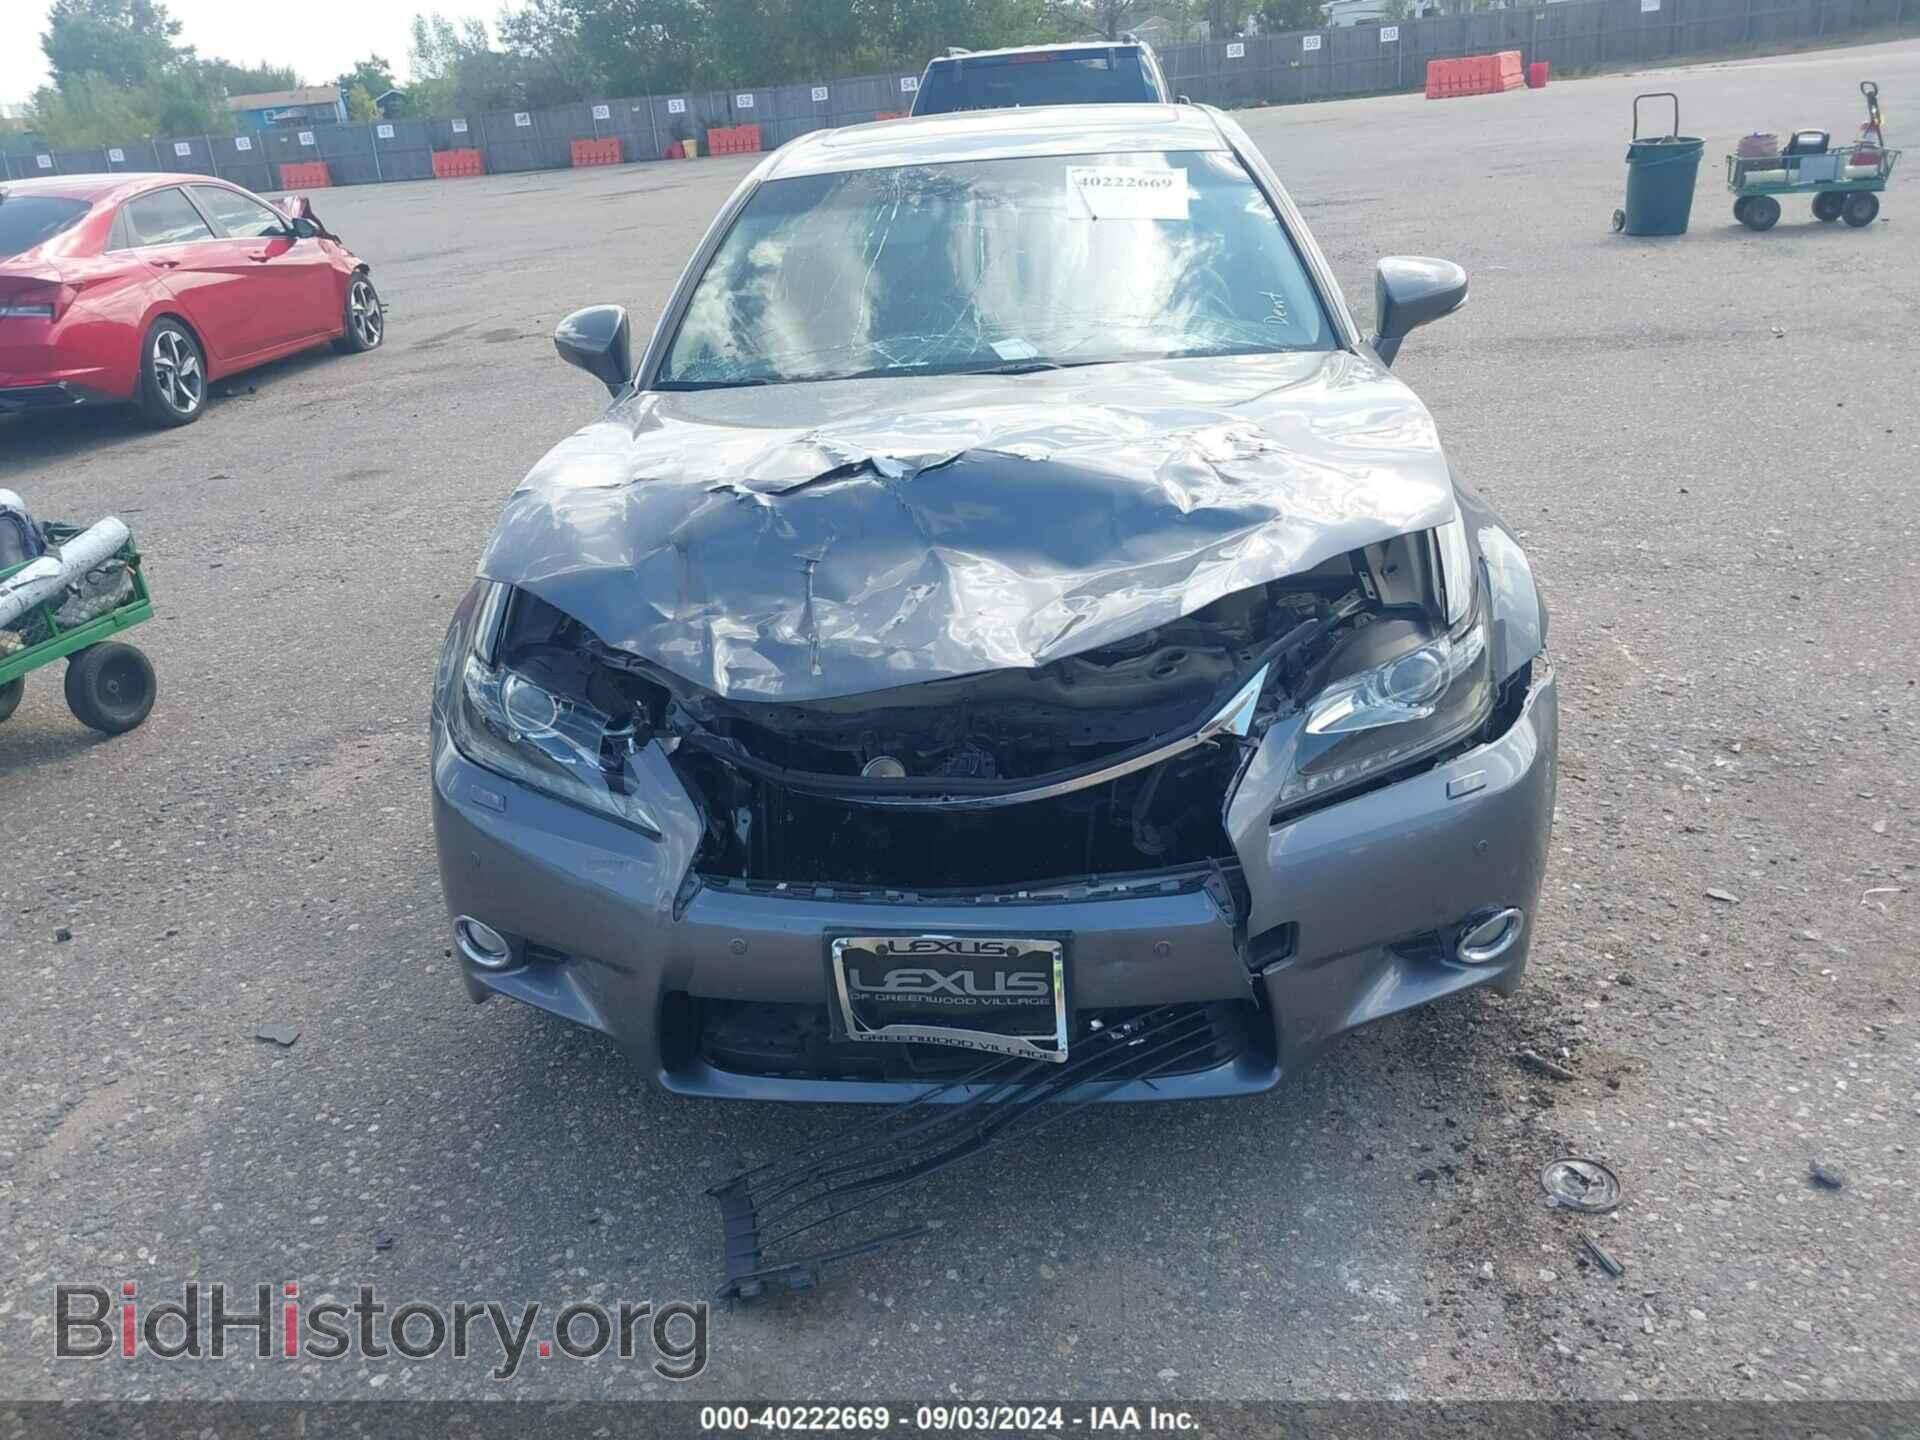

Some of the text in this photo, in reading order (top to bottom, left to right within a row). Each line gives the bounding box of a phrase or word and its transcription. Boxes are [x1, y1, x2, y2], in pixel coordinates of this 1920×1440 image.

[1079, 177, 1173, 188] 40222669
[888, 940, 1005, 955] LEXUS
[849, 968, 1050, 996] LEXUS
[851, 993, 1051, 1006] OF GREENWOOD VILLAGE
[860, 1033, 974, 1048] GREENWOOD
